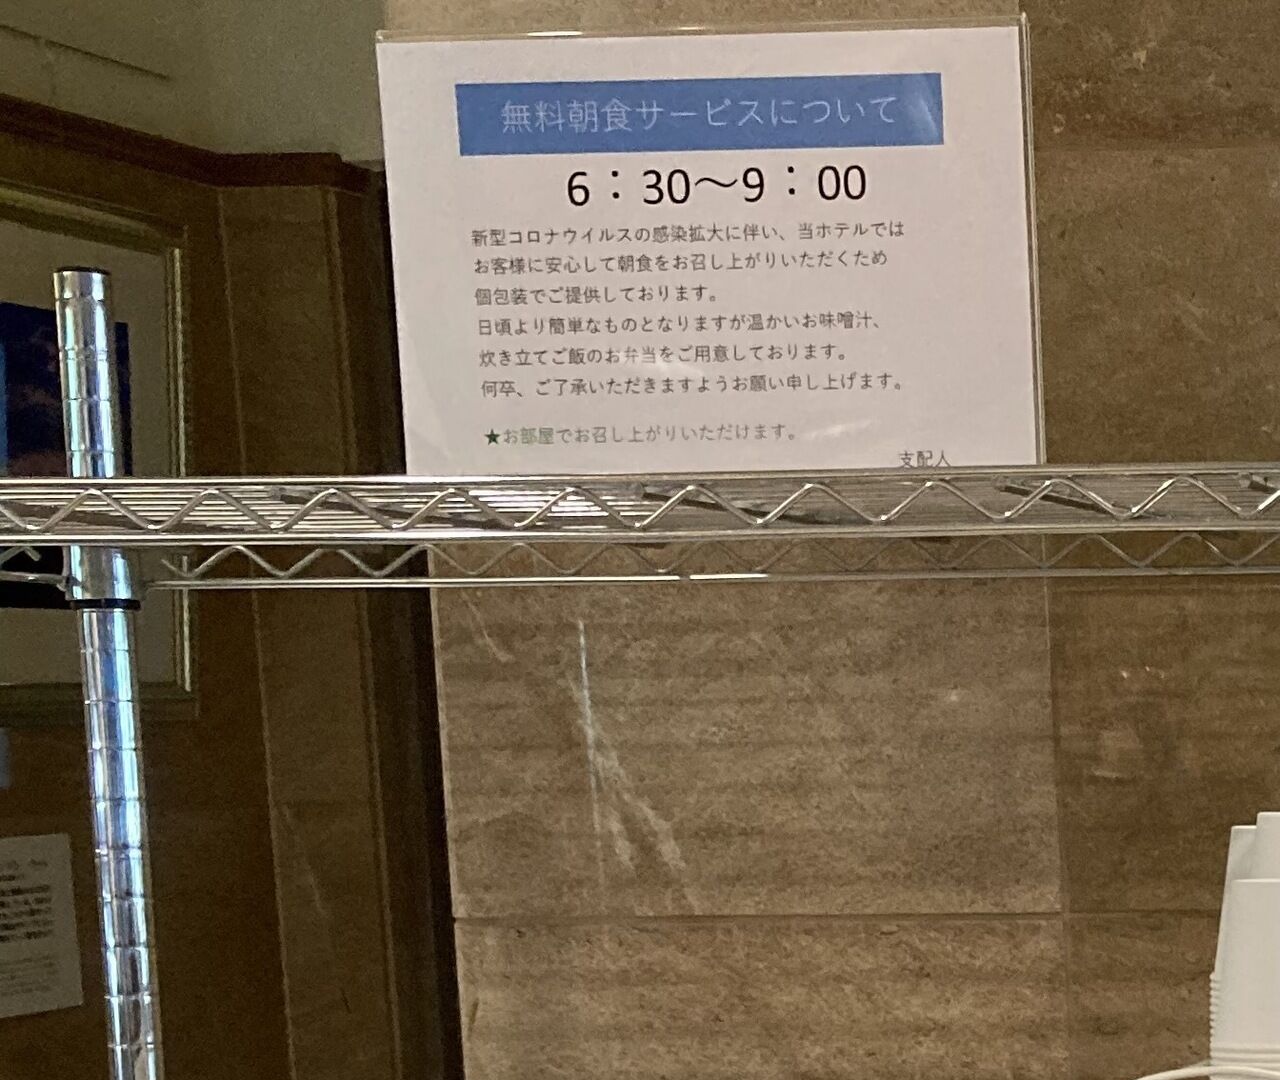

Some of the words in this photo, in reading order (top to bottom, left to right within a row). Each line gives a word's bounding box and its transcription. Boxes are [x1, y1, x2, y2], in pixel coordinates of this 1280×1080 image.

[501, 96, 898, 134] 無料朝食サービスについて
[471, 220, 905, 247] 新型コロナウイルスの感染拡大に伴い、当ホテルでは
[474, 250, 888, 275] お客様に安心して朝食をお召し上がりいただくため
[474, 284, 717, 306] 個包装でご提供しております。
[478, 311, 880, 336] 日頃より簡単なものとなりますが温かいお味噌汁、
[479, 344, 847, 368] 炊き立てご飯のお弁当をご用意しております。
[481, 371, 902, 398] 何卒、ご了承いただきますようお願い申し上げます。
[900, 450, 952, 468] 支配人
